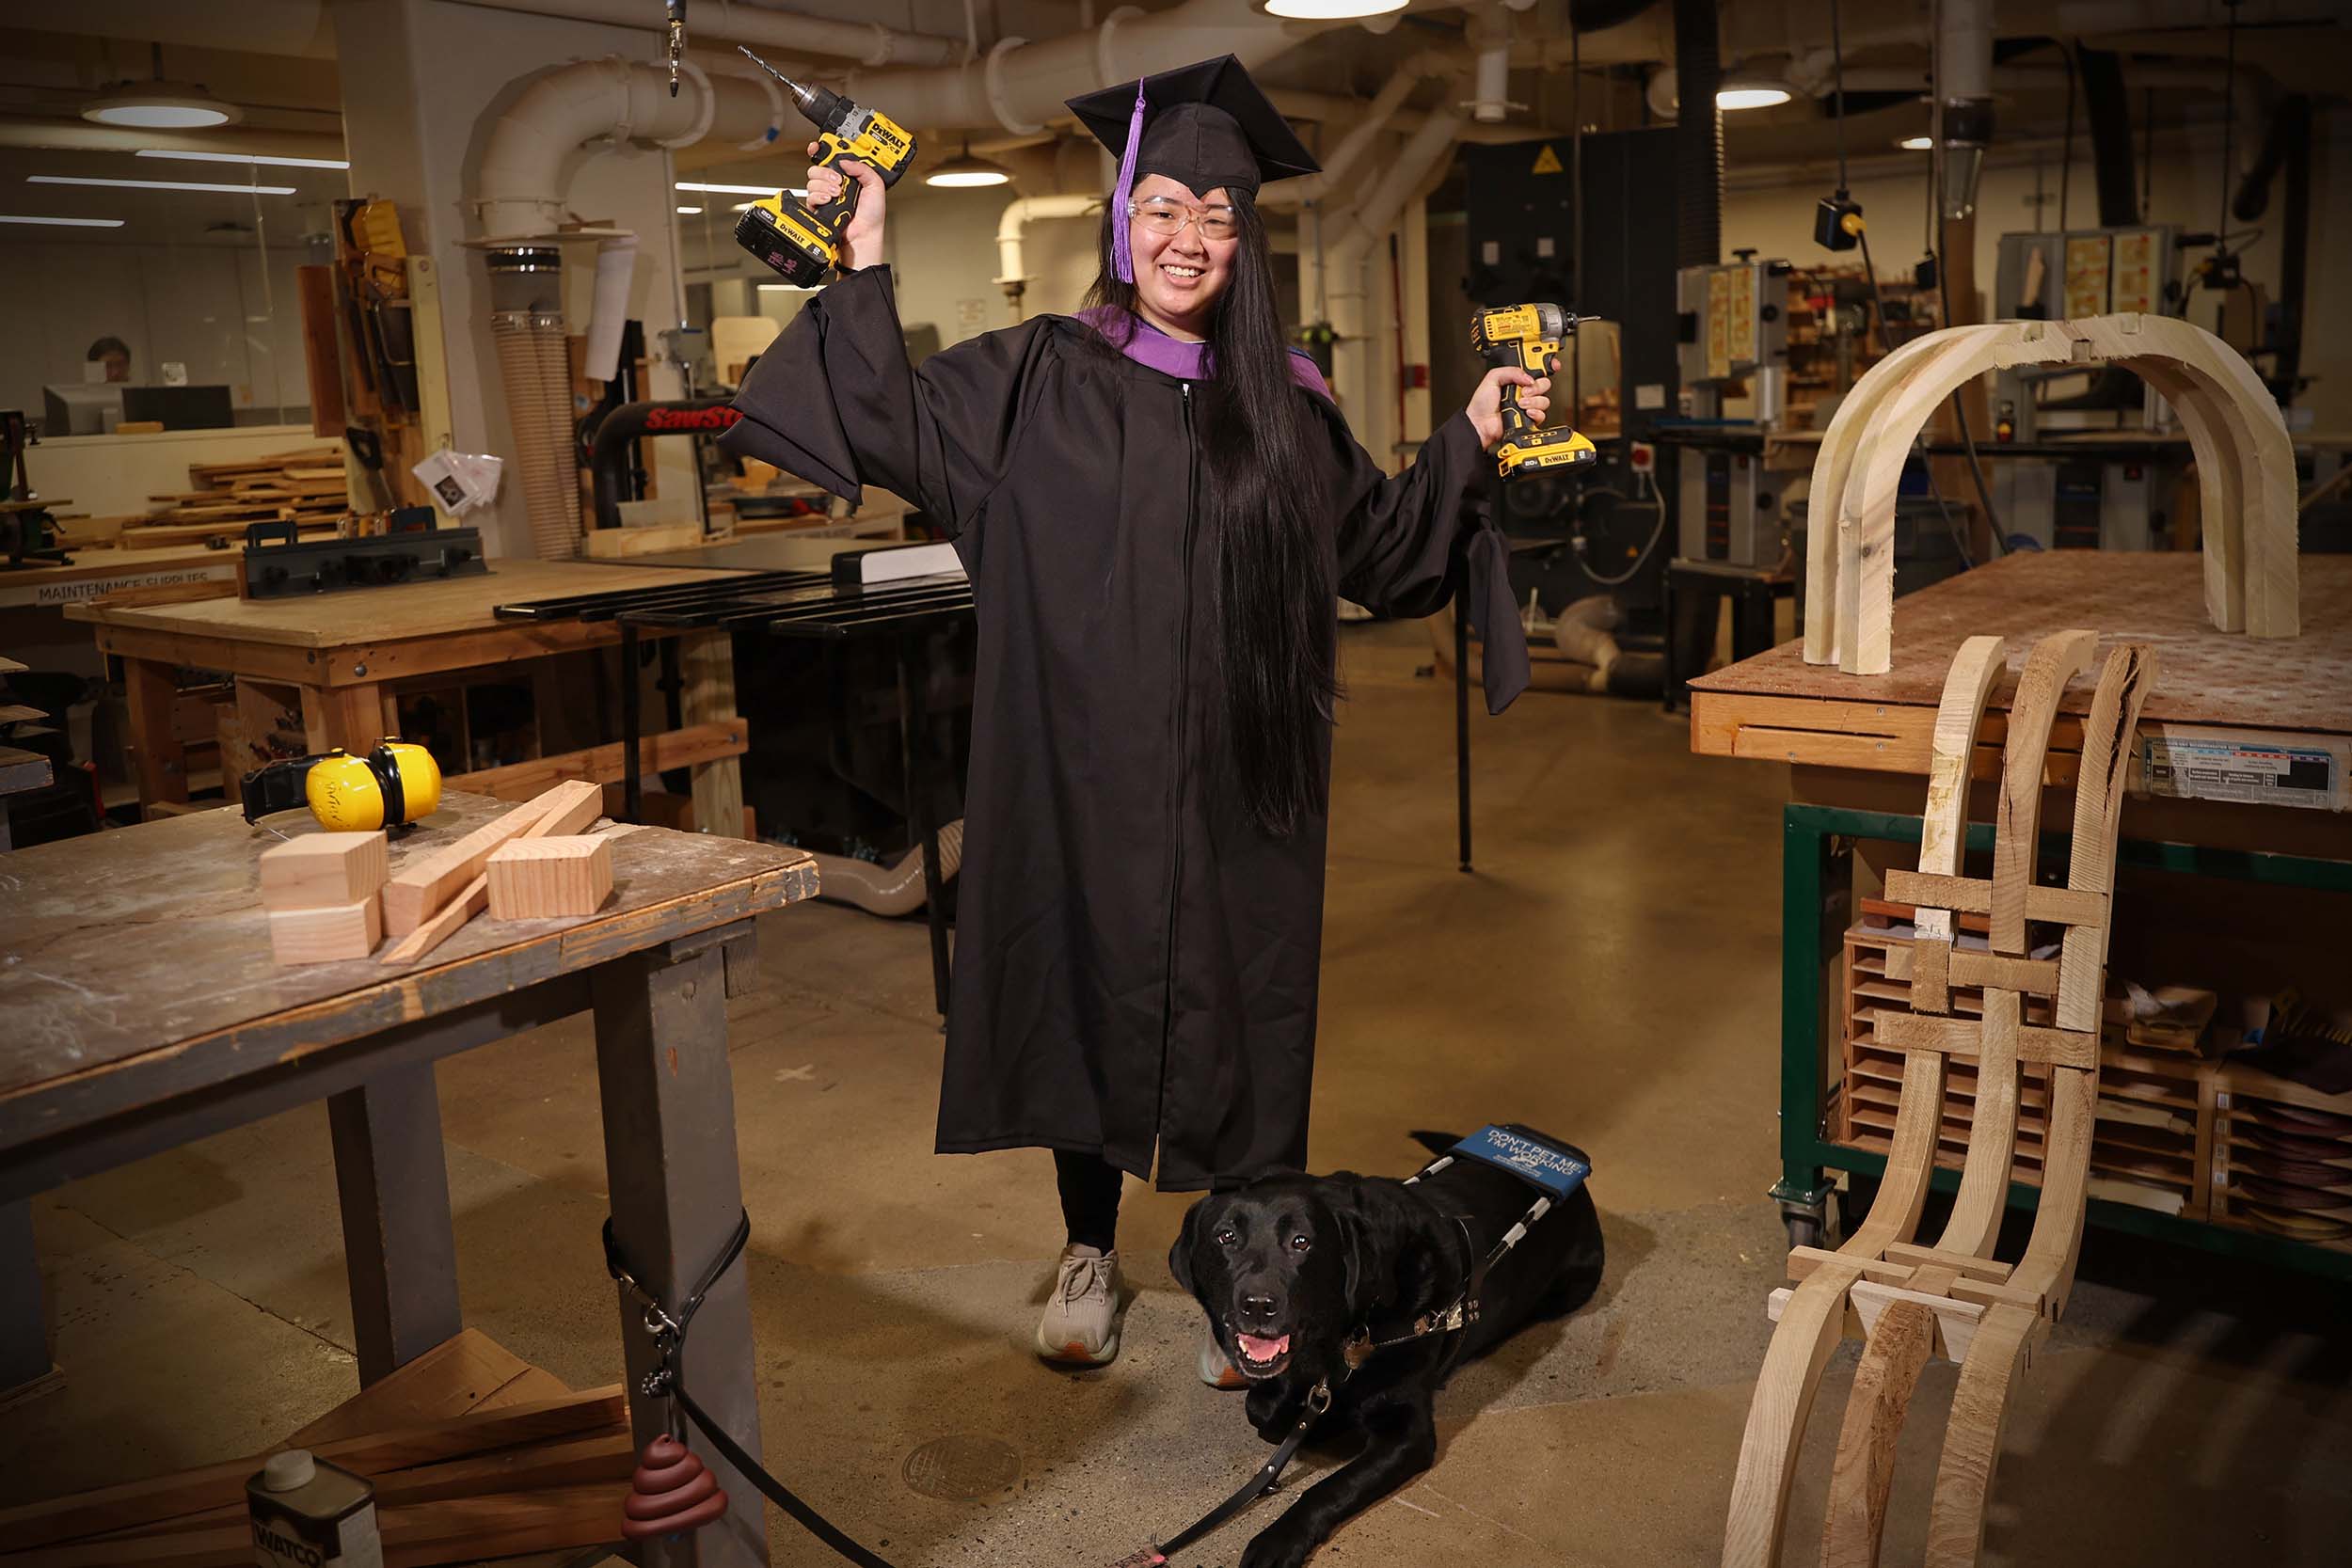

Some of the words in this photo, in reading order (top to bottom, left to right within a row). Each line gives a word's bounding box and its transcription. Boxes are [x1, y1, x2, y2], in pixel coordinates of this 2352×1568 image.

[1486, 1137, 1506, 1149] I'M
[1508, 1146, 1574, 1176] WORKING
[1487, 1130, 1532, 1149] DON'T
[1531, 1147, 1560, 1161] PET
[255, 1523, 321, 1567] WATCO
